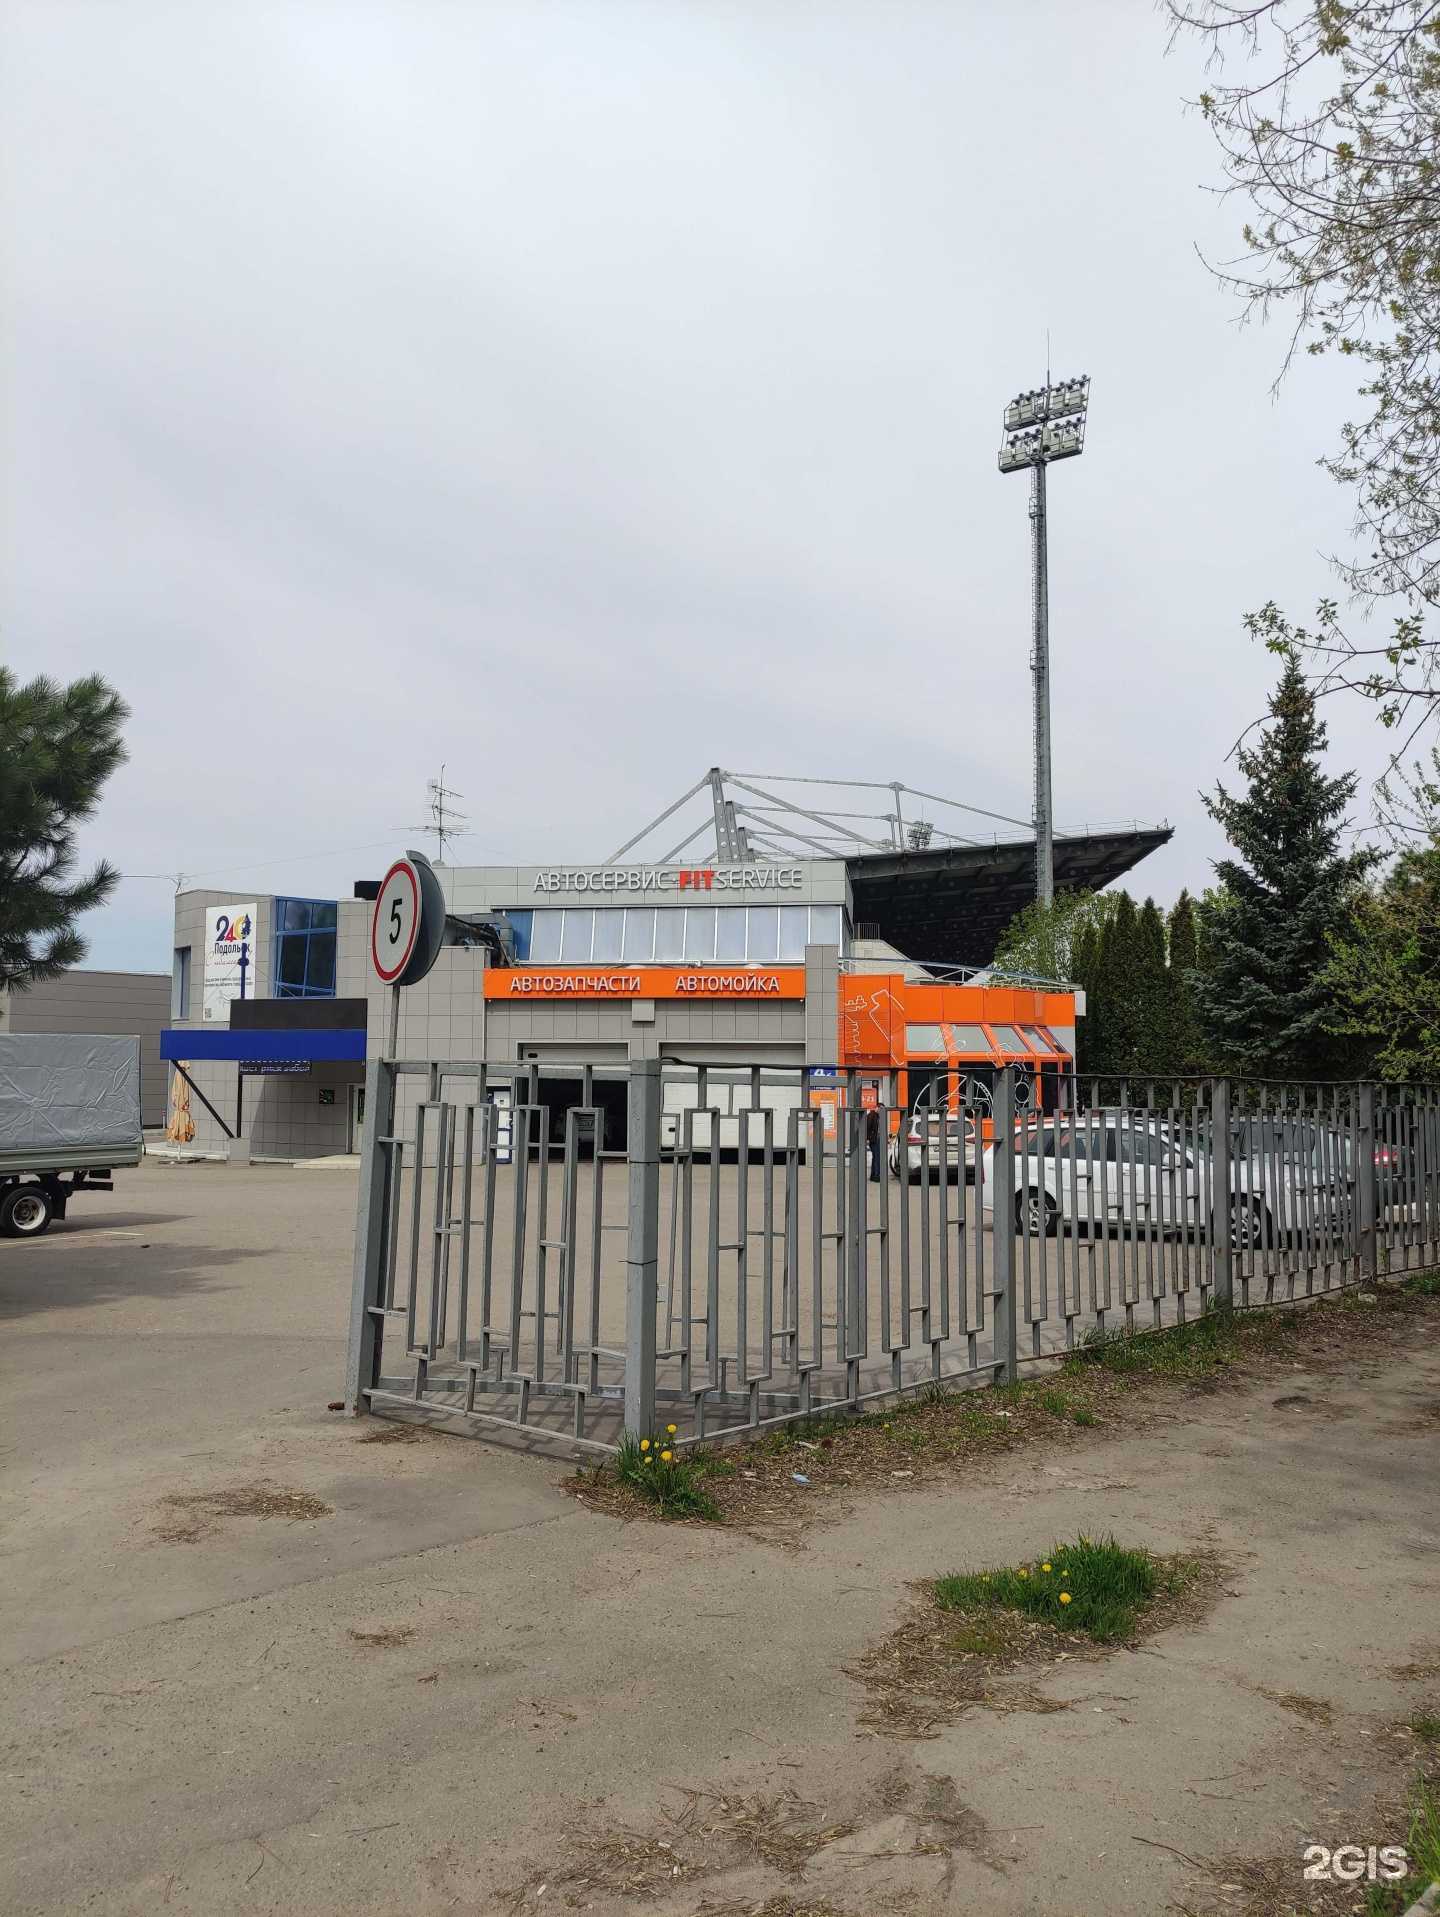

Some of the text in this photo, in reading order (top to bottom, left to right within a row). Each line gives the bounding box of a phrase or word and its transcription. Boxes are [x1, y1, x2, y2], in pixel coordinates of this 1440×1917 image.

[534, 871, 670, 892] АВТОСЕРВИС
[389, 898, 403, 945] 5
[214, 942, 251, 957] Подольк
[510, 973, 780, 993] АВТОЗАПЧАСТИ АВТОМОЙКА
